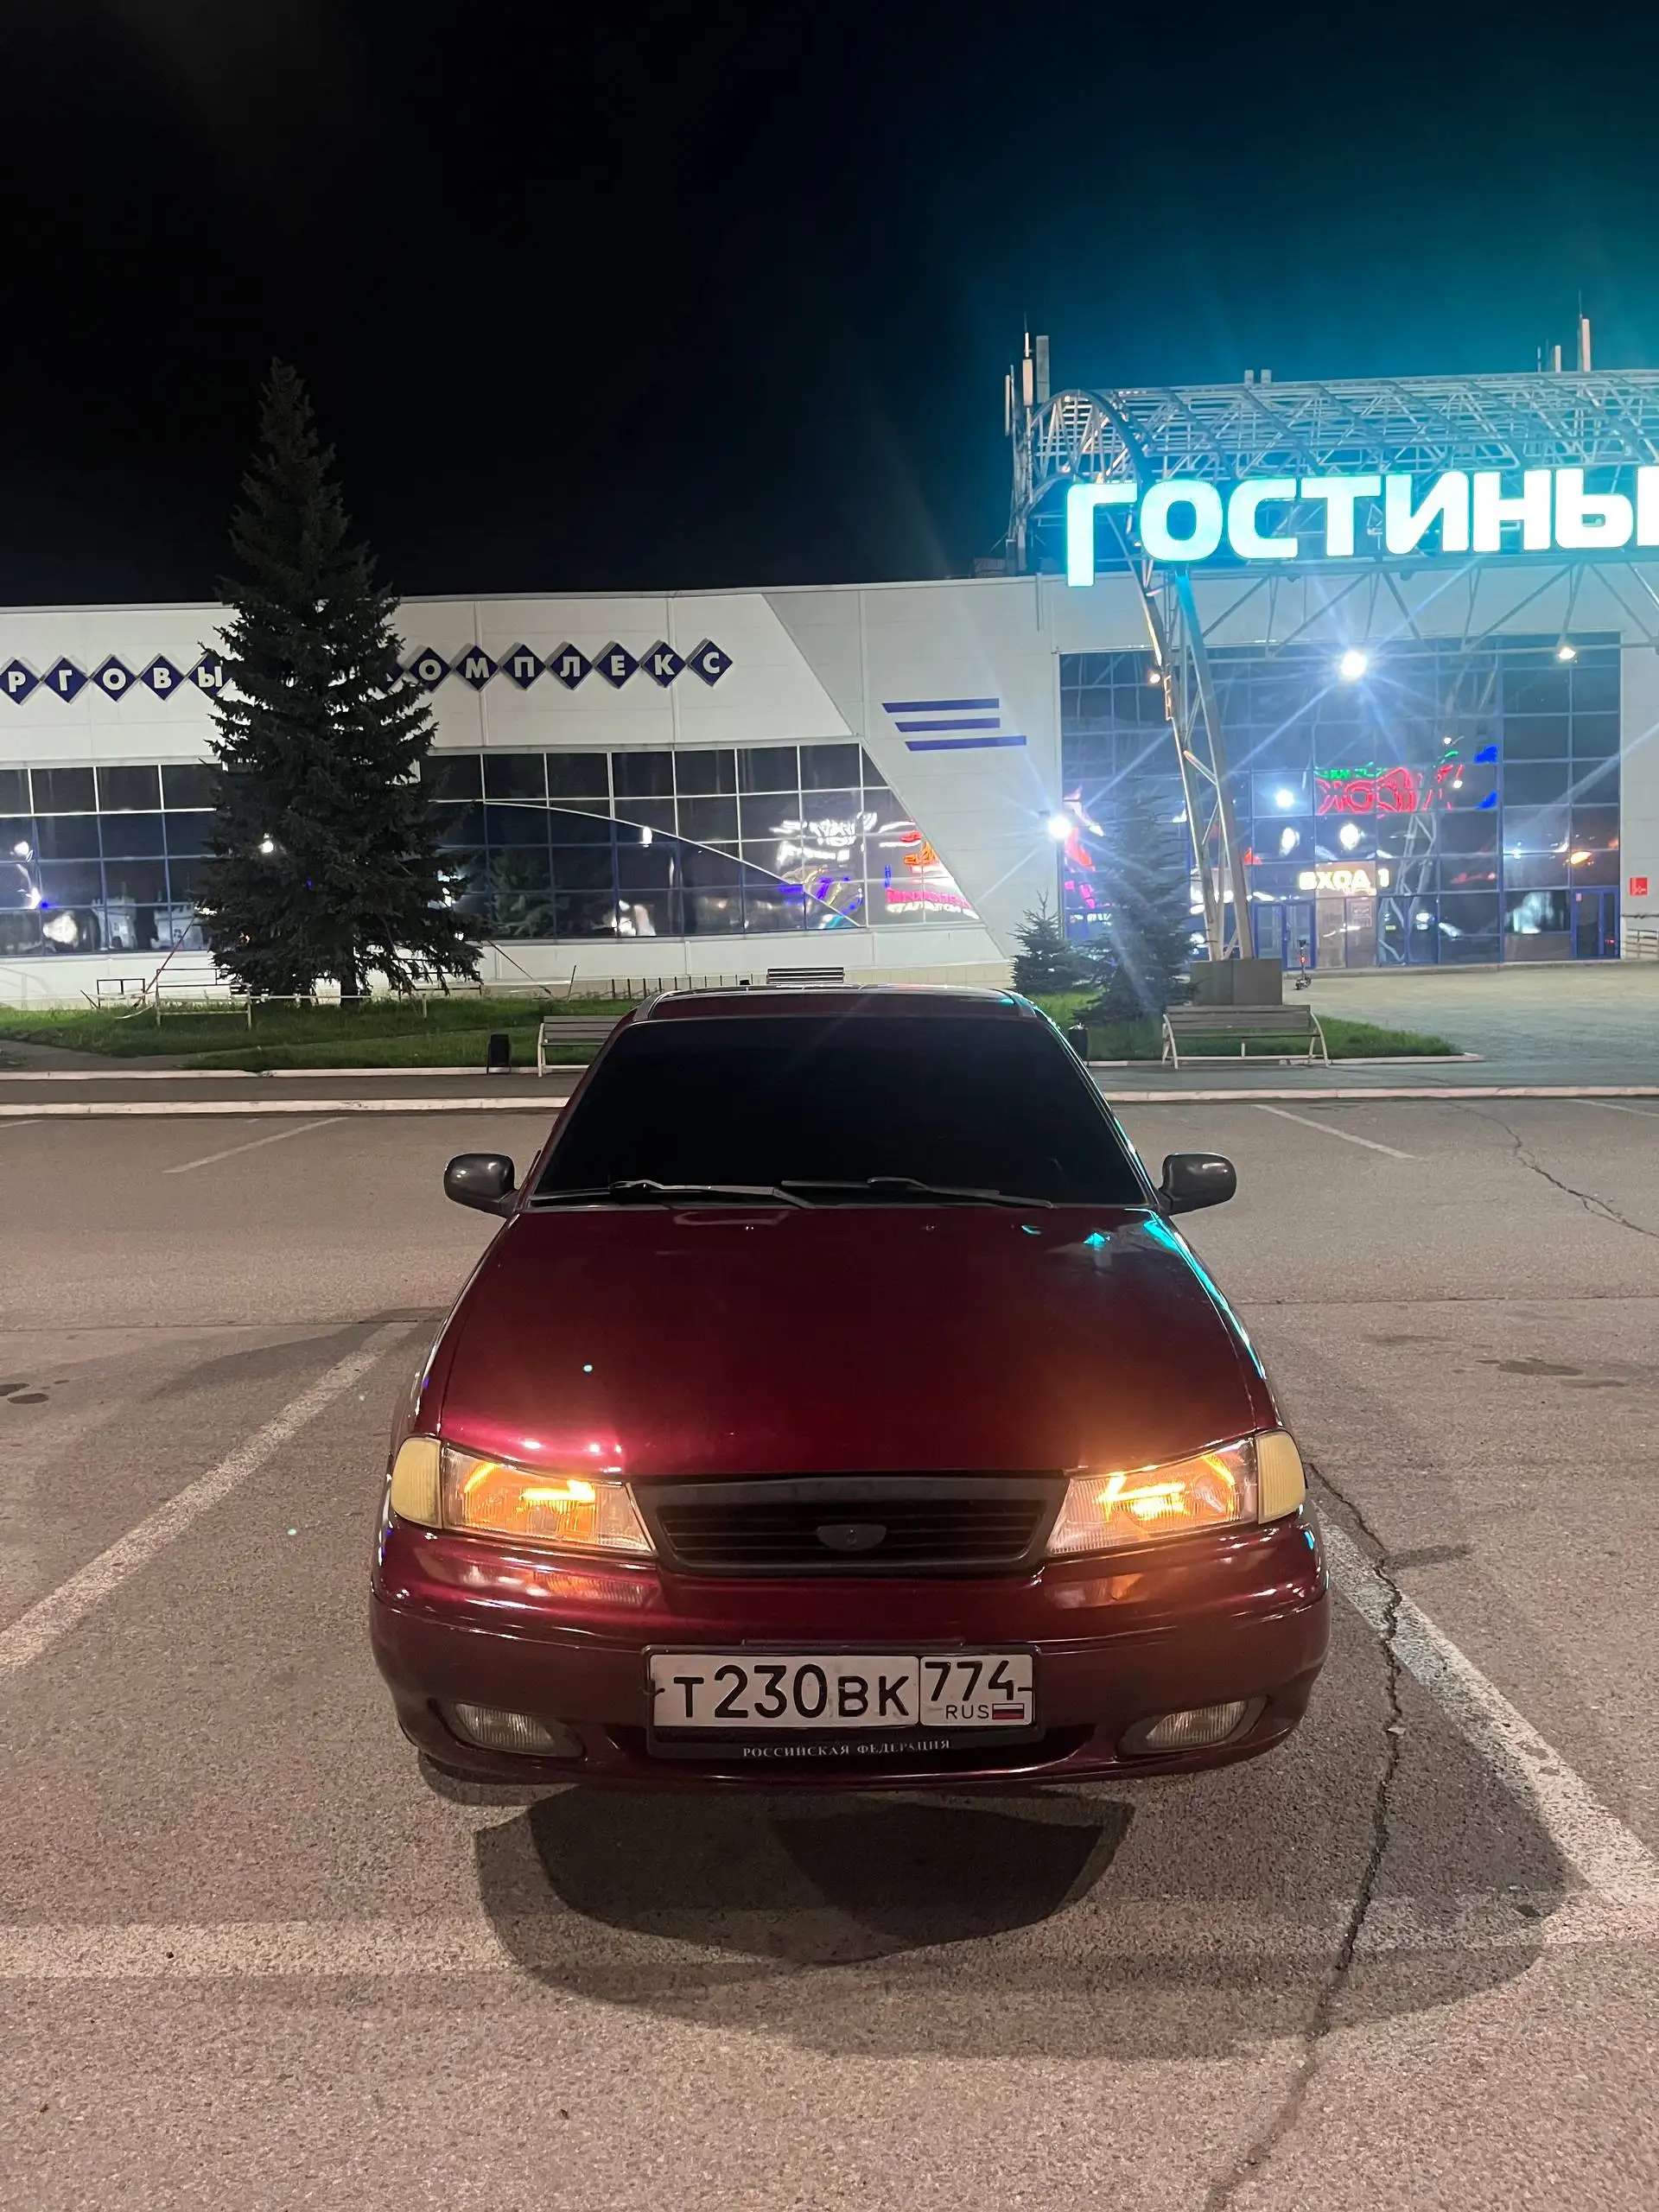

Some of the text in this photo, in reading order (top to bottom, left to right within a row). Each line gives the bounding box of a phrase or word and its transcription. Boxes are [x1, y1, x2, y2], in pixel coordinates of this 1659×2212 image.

[1067, 466, 1659, 587] ГОСТИНЫ
[386, 651, 722, 682] ОМПЛЕКС
[1299, 868, 1390, 891] ВХОД 1
[924, 1659, 1015, 1702] 774
[945, 1704, 989, 1719] RUS
[743, 1739, 951, 1758] РОССИЙСКАЯ ФЕДЕРАЦИЯ
